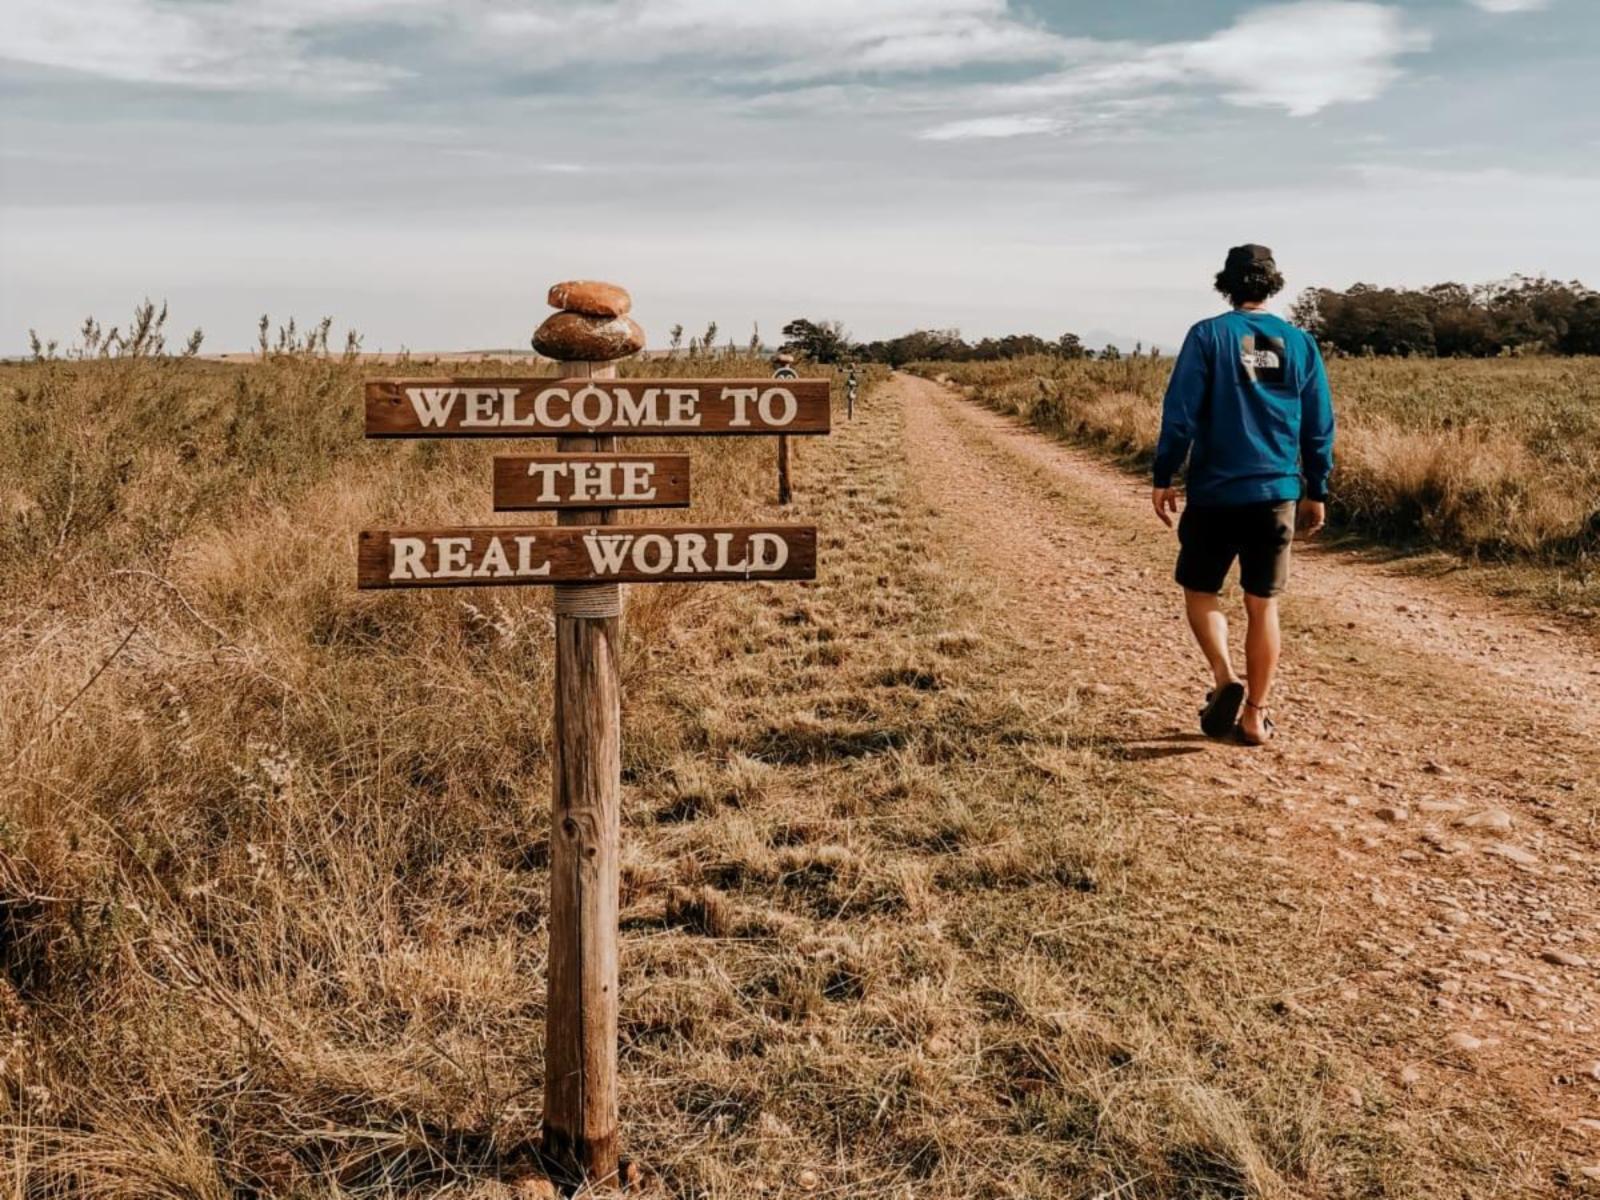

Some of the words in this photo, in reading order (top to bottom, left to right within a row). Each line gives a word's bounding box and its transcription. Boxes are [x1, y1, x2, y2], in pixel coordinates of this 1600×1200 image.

[406, 388, 701, 427] WELCOME
[722, 387, 797, 426] TO
[528, 462, 657, 502] THE
[389, 536, 551, 579] REAL
[583, 533, 789, 575] WORLD
